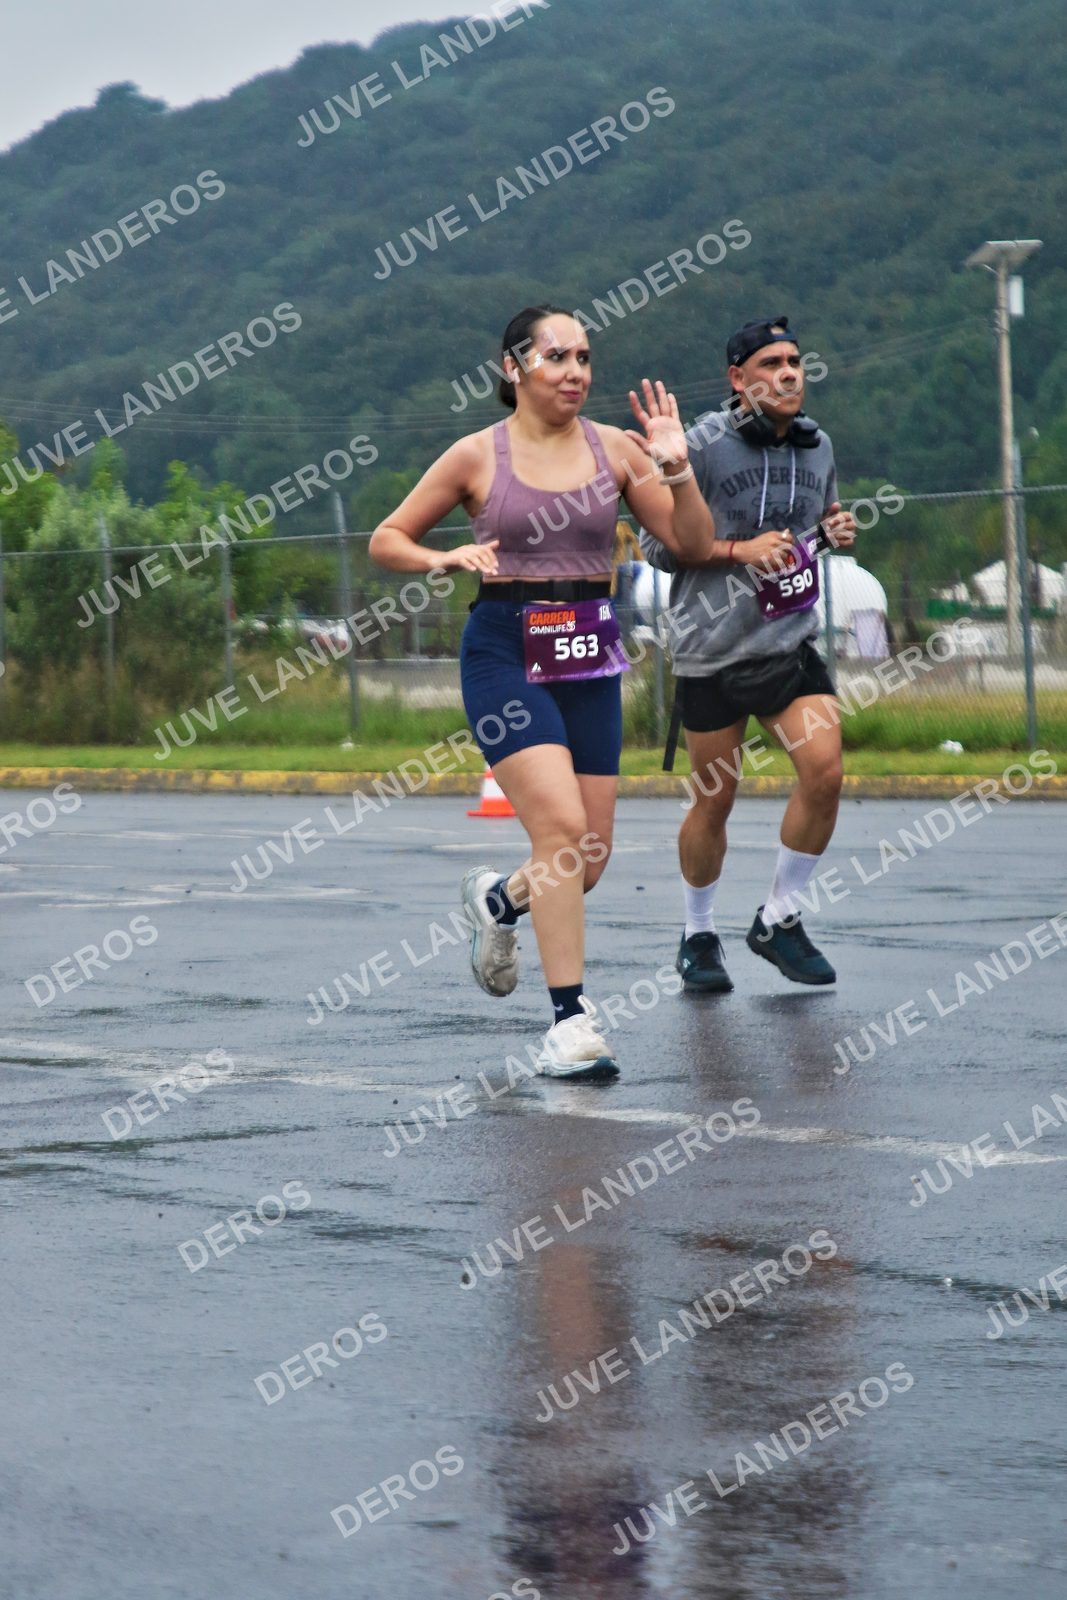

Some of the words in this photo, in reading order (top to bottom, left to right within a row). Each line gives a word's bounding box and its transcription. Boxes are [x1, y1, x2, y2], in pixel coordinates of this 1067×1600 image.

[779, 568, 814, 597] 590
[529, 610, 577, 625] CARRERA
[529, 624, 566, 635] OMNILIFE
[554, 633, 599, 660] 563
